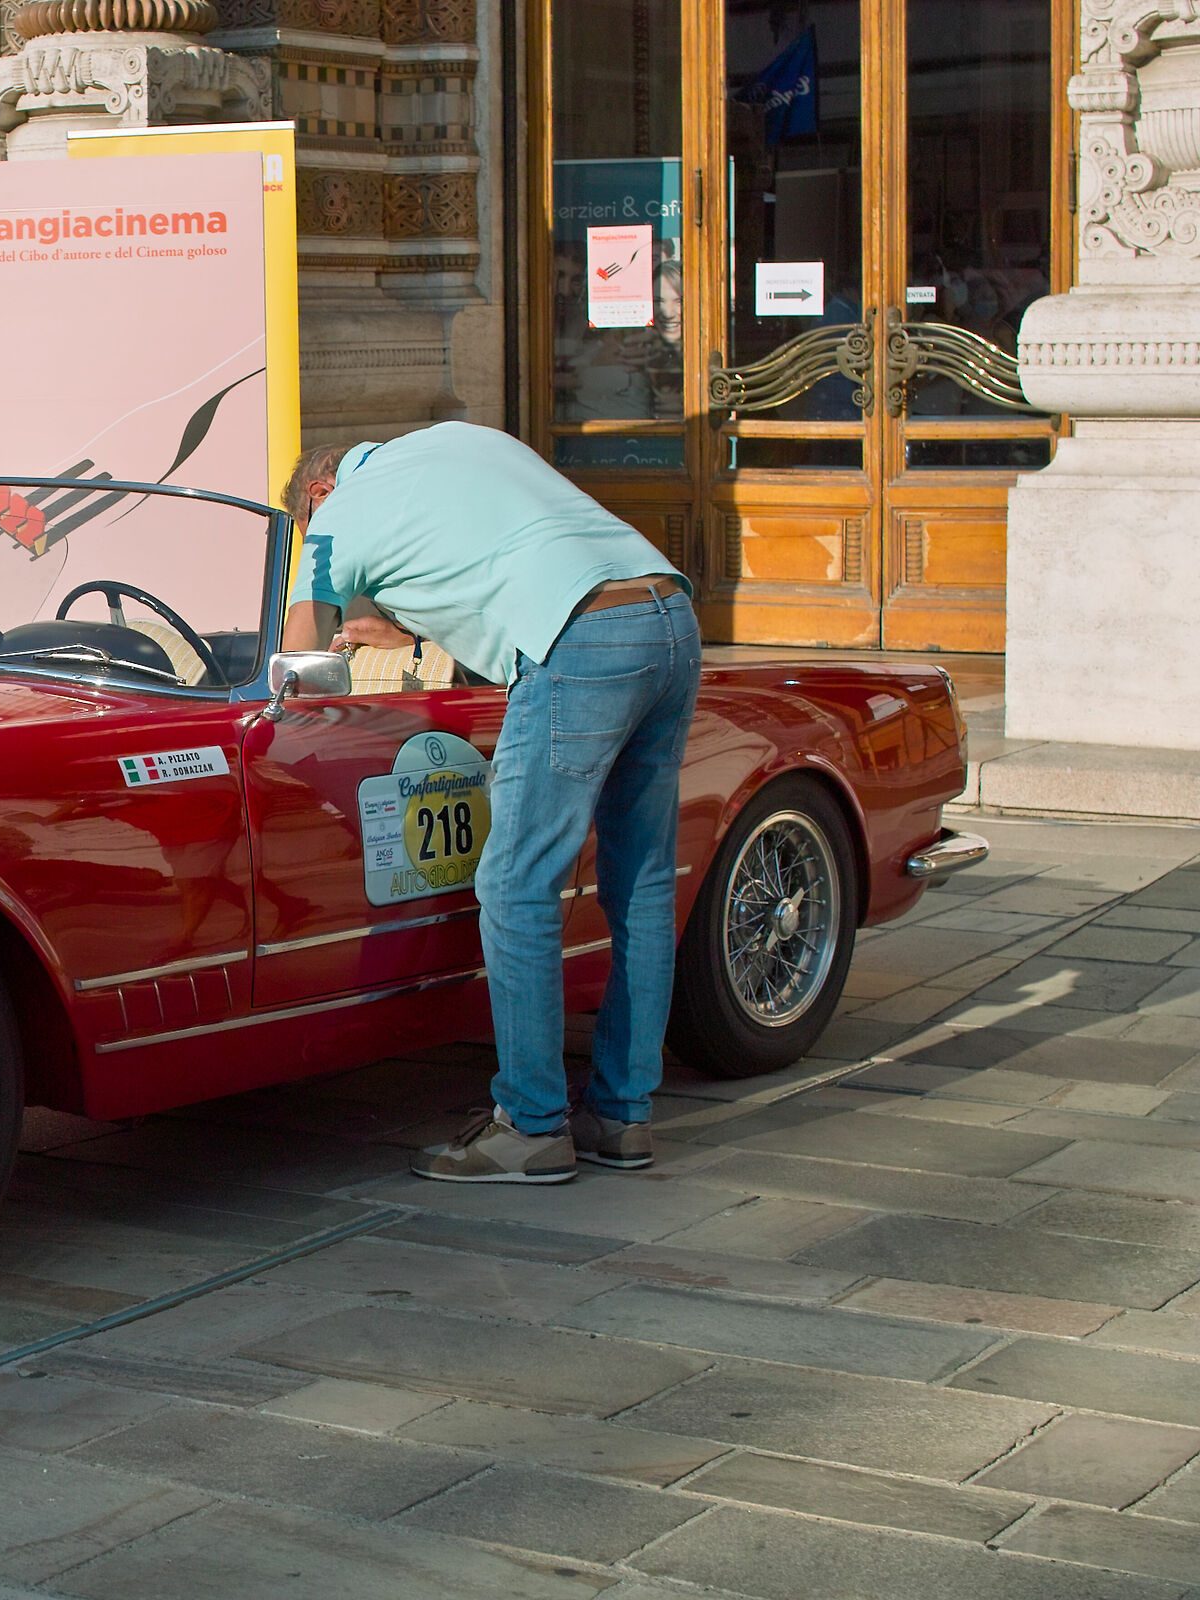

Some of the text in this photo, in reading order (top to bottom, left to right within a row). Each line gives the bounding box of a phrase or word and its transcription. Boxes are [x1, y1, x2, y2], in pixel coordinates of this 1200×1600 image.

[553, 201, 617, 219] erzieri
[622, 195, 639, 217] &
[19, 249, 48, 262] Cibo
[52, 247, 101, 261] d'autore
[104, 251, 112, 259] e
[114, 246, 133, 259] del
[136, 245, 184, 259] Cinema
[187, 244, 228, 260] goloso
[158, 752, 200, 765] A. PIZZATO
[162, 763, 214, 778] R. DONAZZAN
[398, 770, 486, 802] Confartigianato
[417, 801, 473, 862] 218
